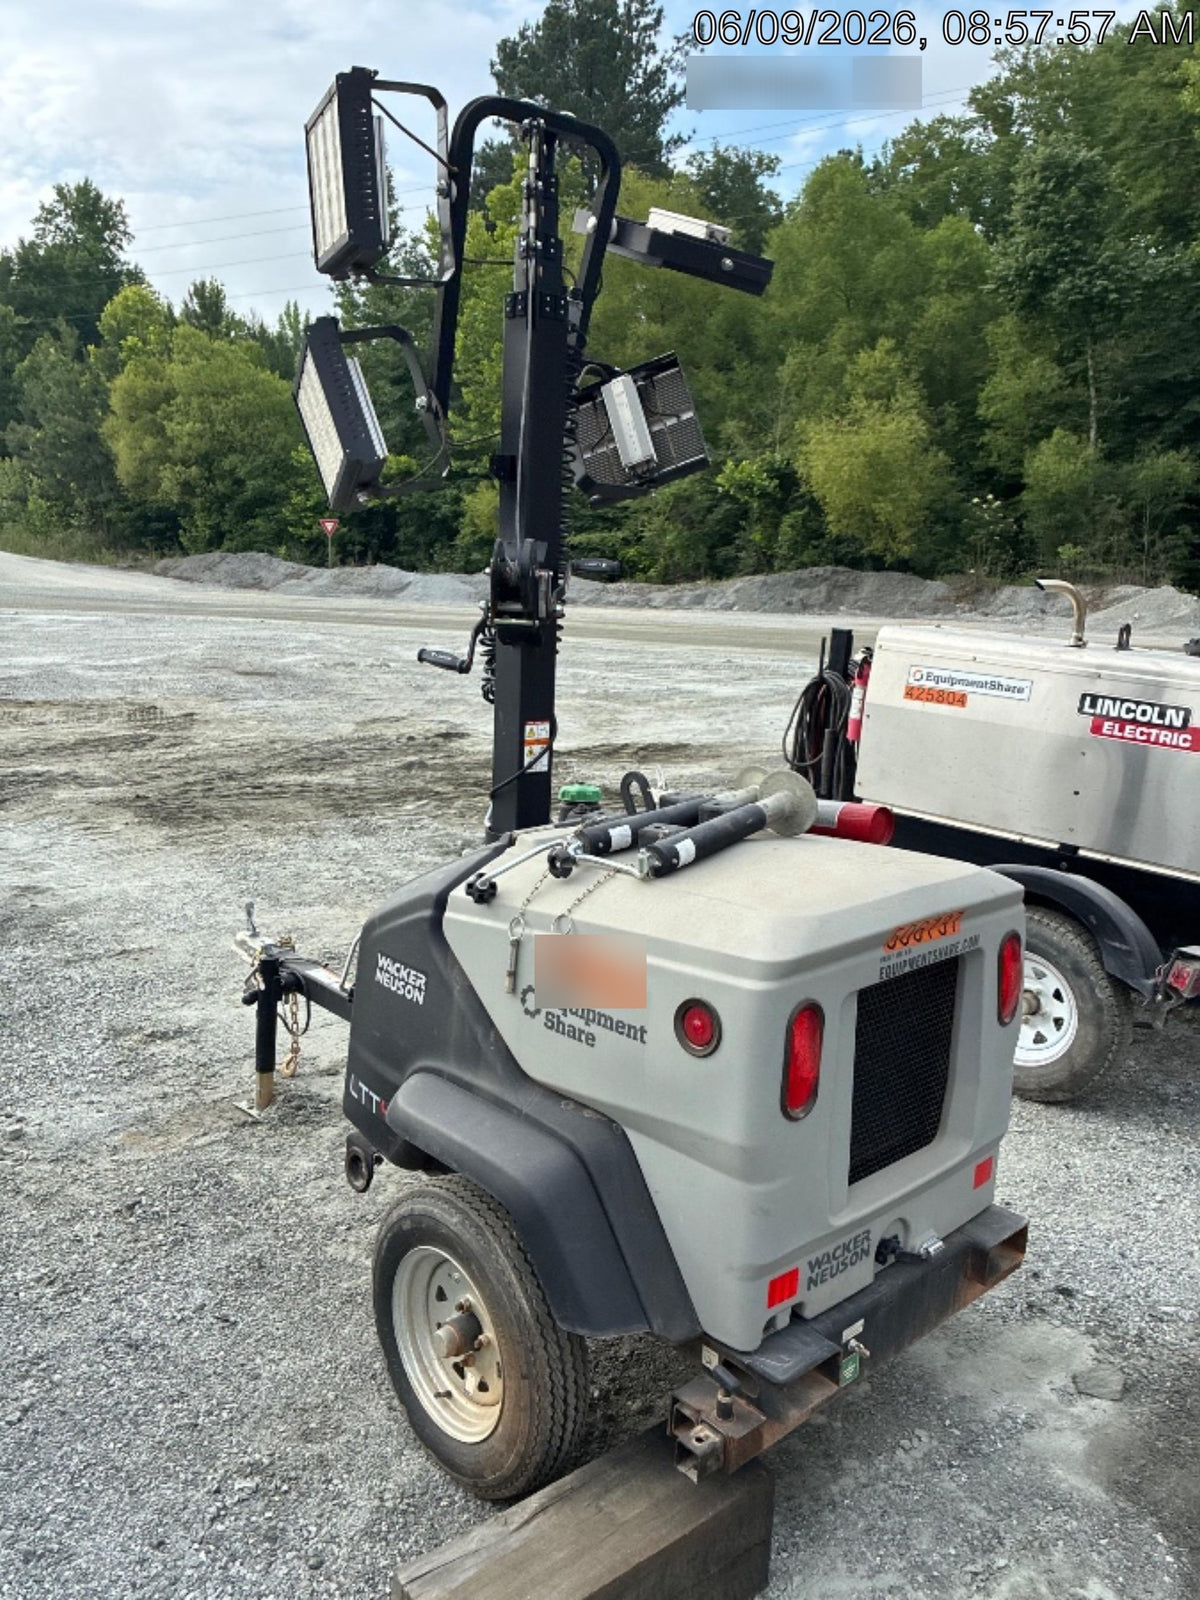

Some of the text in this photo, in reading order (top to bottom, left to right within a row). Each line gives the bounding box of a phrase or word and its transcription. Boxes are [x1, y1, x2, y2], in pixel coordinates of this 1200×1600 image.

[904, 685, 967, 708] 425804
[925, 672, 1025, 695] EquipmentShare
[1082, 696, 1185, 728] LINCOLN
[1102, 721, 1192, 748] ELECTRIC
[375, 968, 426, 1006] NEUSON
[377, 952, 426, 990] WACKER
[543, 1011, 597, 1048] Share
[558, 1008, 648, 1044] uipment
[806, 1244, 871, 1291] NEUSON
[807, 1229, 872, 1274] WACKER
